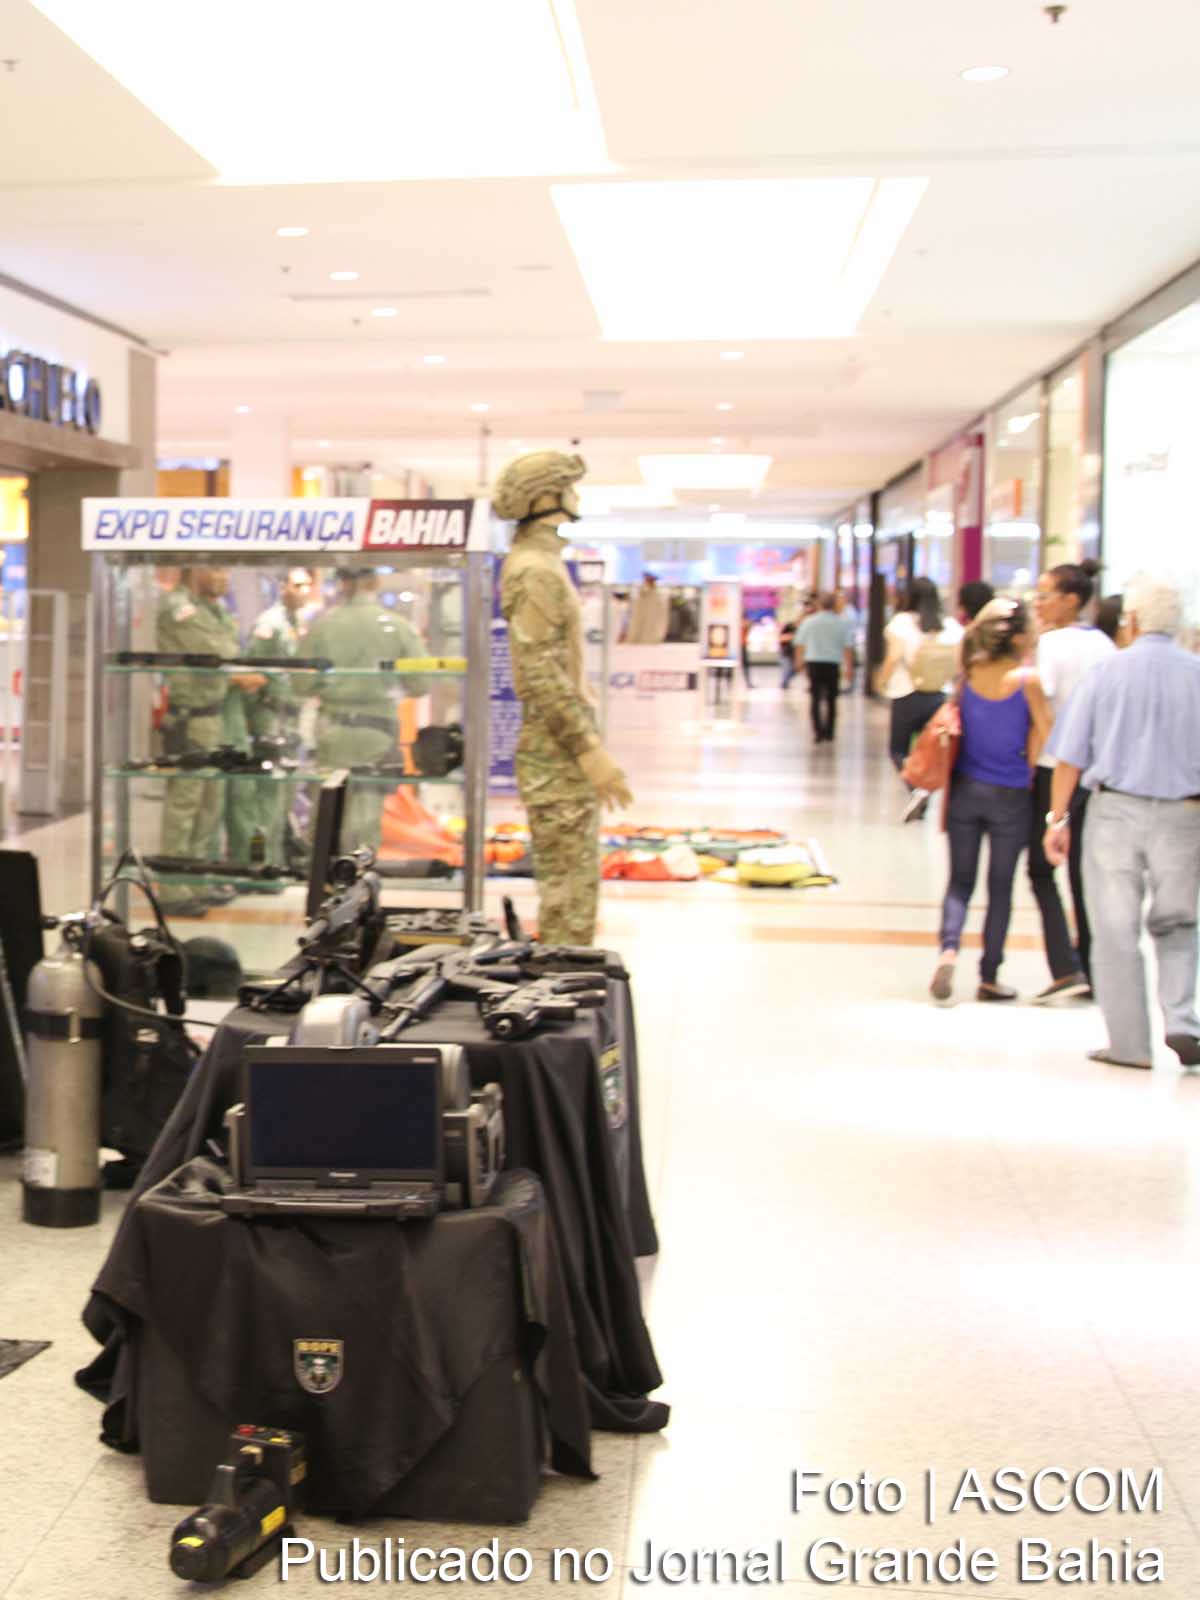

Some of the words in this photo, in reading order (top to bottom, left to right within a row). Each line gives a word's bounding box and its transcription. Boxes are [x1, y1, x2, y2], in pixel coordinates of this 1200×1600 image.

[95, 508, 169, 541] EXPO
[176, 508, 356, 551] SEGURANÇA
[368, 508, 466, 547] BAHIA
